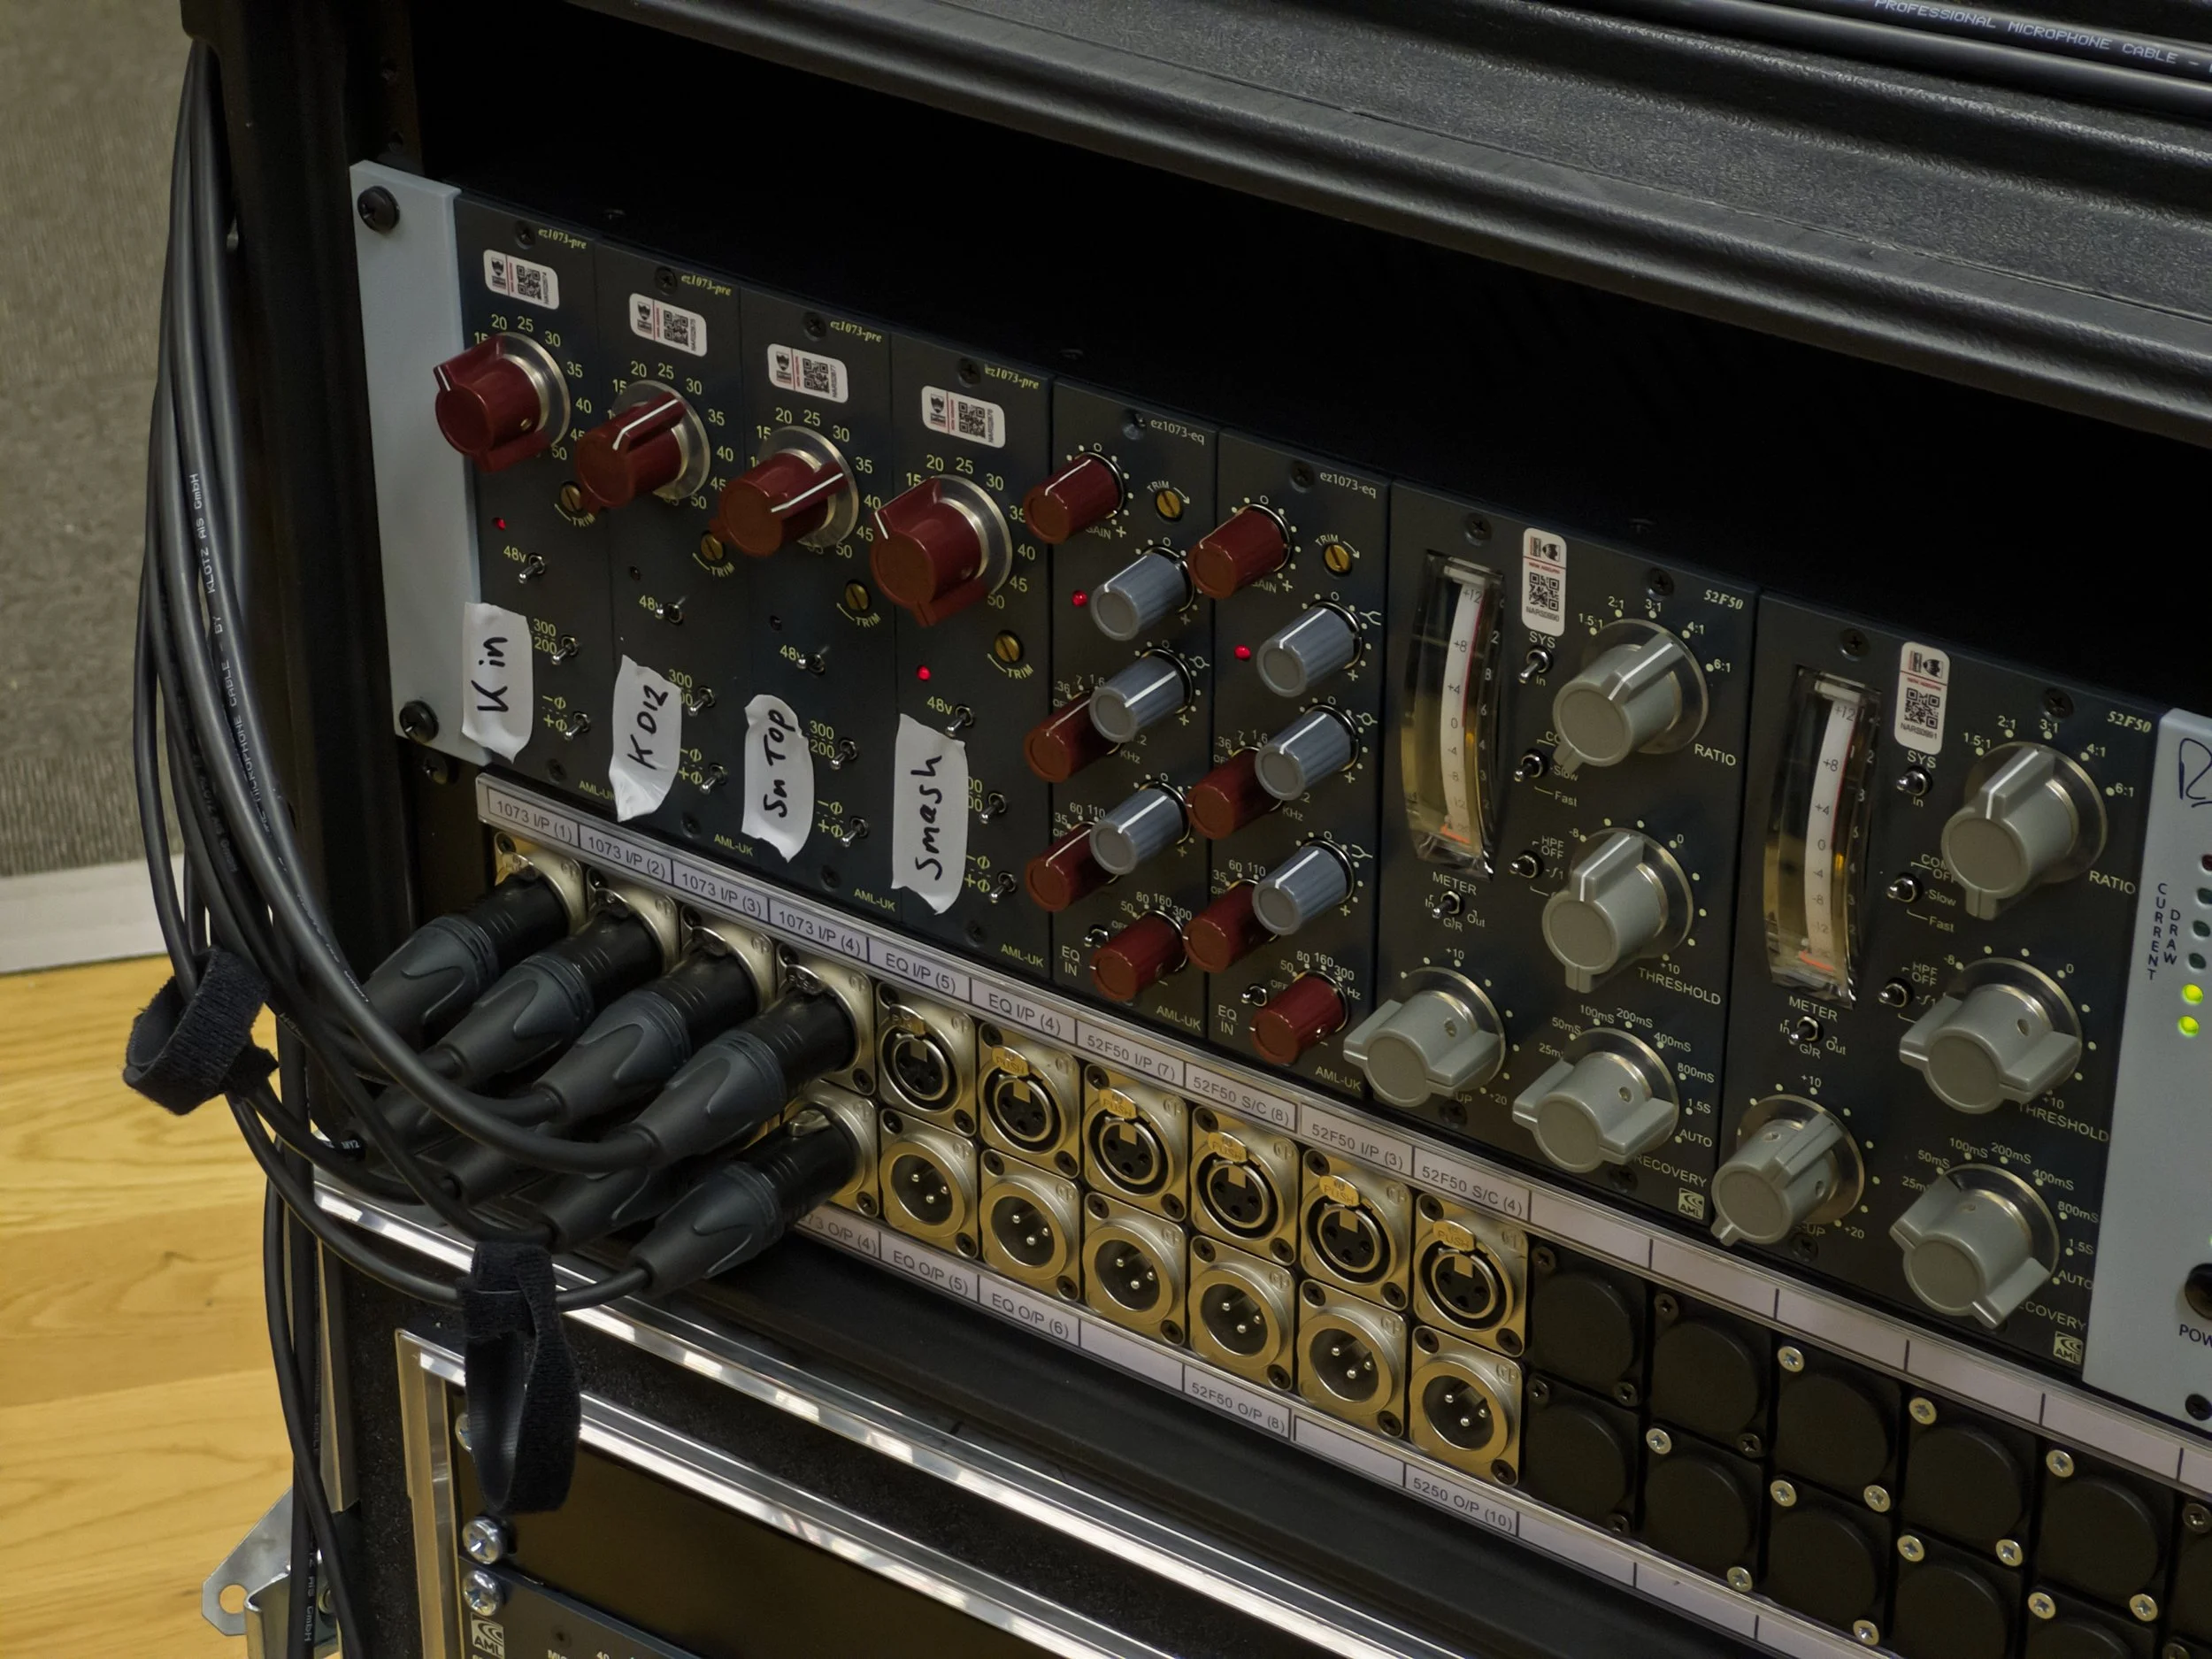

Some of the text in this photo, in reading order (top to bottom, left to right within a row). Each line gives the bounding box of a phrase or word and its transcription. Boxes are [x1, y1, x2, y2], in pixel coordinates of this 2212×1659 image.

[1875, 0, 2178, 65] PROFESSIONAL MICROPHONE CABLE
[537, 227, 588, 250] ez1073-pre
[681, 273, 732, 296] ez1073-pre
[491, 313, 508, 331] 20
[517, 316, 534, 333] 25
[829, 319, 882, 343] ez1073-pre
[544, 330, 561, 348] 30
[566, 361, 583, 379] 35
[631, 360, 648, 378] 20
[657, 363, 674, 380] 25
[984, 363, 1041, 390] ez1073-pre
[686, 378, 703, 396] 30
[575, 397, 592, 414] 40
[775, 407, 793, 424] 20
[709, 408, 726, 426] 35
[803, 410, 821, 426] 25
[833, 425, 850, 442] 30
[1150, 419, 1206, 445] ez1073-eq
[551, 445, 568, 461] 50
[717, 445, 733, 463] 40
[926, 454, 945, 472] 20
[856, 457, 873, 474] 35
[956, 457, 974, 474] 25
[188, 472, 203, 510] GmbH
[986, 472, 1004, 490] 30
[1319, 472, 1378, 499] ez1073-eq
[690, 495, 707, 511] 50
[864, 494, 881, 511] 40
[571, 512, 596, 528] TRIM
[856, 526, 874, 542] 45
[835, 541, 853, 558] 50
[1018, 543, 1036, 561] 40
[200, 546, 216, 594] KLOTZ
[710, 561, 736, 578] TRIM
[1010, 575, 1027, 592] 45
[987, 594, 1005, 610] 50
[1704, 589, 1744, 610] 52F50
[212, 616, 223, 634] BY
[533, 618, 557, 638] 300
[855, 612, 881, 629] TRIM
[534, 636, 557, 656] 200
[1529, 630, 1556, 649] SYS
[668, 668, 693, 689] 300
[1007, 664, 1034, 680] TRIM
[221, 659, 237, 707] CABLE
[926, 695, 953, 716] 48v
[809, 719, 834, 740] 300
[2106, 710, 2152, 733] 52F50
[810, 738, 835, 758] 200
[1694, 743, 1737, 766] RATIO
[2086, 744, 2106, 757] 4:1
[1907, 749, 1936, 768] SYS
[1069, 802, 1083, 815] 60
[1555, 790, 1578, 807] Fast
[497, 800, 572, 844] 1073 I/P (1)
[713, 833, 753, 857] AML-UK
[1541, 835, 1564, 849] HPF
[588, 836, 666, 879] 1073 I/P (2)
[1541, 846, 1563, 859] OFF
[1432, 872, 1477, 895] METER
[2089, 871, 2136, 895] RATIO
[682, 872, 762, 918] 1073 I/P (3)
[854, 887, 896, 912] AML-UK
[1153, 893, 1172, 908] 160
[1928, 889, 1956, 907] Slow
[1172, 905, 1192, 921] 300
[780, 910, 860, 958] 1073 I/P (4)
[1929, 917, 1955, 933] Fast
[2147, 882, 2168, 980] CURRENT
[2163, 909, 2180, 965] DRAW
[1000, 942, 1044, 968] AML-UK
[1062, 945, 1080, 963] EQ
[1296, 950, 1310, 964] 80
[1314, 952, 1333, 968] 160
[886, 953, 956, 995] EQ I/P (5)
[1064, 962, 1078, 976] IN
[1334, 964, 1355, 980] 300
[1912, 961, 1938, 975] HPF
[1639, 967, 1721, 1005] THRESHOLD
[1912, 972, 1937, 987] OFF
[1348, 987, 1362, 1000] Hz
[989, 994, 1061, 1035] EQ I/P (4)
[1218, 1004, 1238, 1021] EQ
[1580, 1004, 1615, 1025] 100mS
[1789, 995, 1837, 1020] METER
[1156, 1005, 1202, 1031] AML-UK
[1220, 1020, 1233, 1036] IN
[1616, 1008, 1654, 1029] 200mS
[1653, 1032, 1692, 1053] 400mS
[1087, 1035, 1176, 1080] 52F50 I/P (7)
[1315, 1065, 1362, 1092] AML-UK
[1677, 1063, 1715, 1083] 800mS
[1194, 1077, 1289, 1126] 52F50 S/C (8)
[2018, 1102, 2109, 1142] THRESHOLD
[1312, 1124, 1403, 1171] 52F50 I/P (3)
[1680, 1129, 1713, 1148] AUTO
[1949, 1137, 1988, 1159] 100mS
[1917, 1149, 1951, 1169] 50mS
[1991, 1141, 2032, 1164] 200mS
[1635, 1154, 1708, 1187] RECOVERY
[2032, 1168, 2075, 1192] 400mS
[1422, 1166, 1523, 1217] 52F50 S/C (4)
[2057, 1201, 2099, 1223] 800mS
[828, 1222, 877, 1256] O/P (4)
[893, 1250, 969, 1296] EQ O/P (5)
[2058, 1269, 2093, 1290] AUTO
[992, 1292, 1070, 1340] EQ O/P (6)
[1192, 1381, 1286, 1434] 52F50 O/P (8)
[1413, 1478, 1513, 1533] 5250 O/P (10)
[473, 1635, 503, 1657] AML
